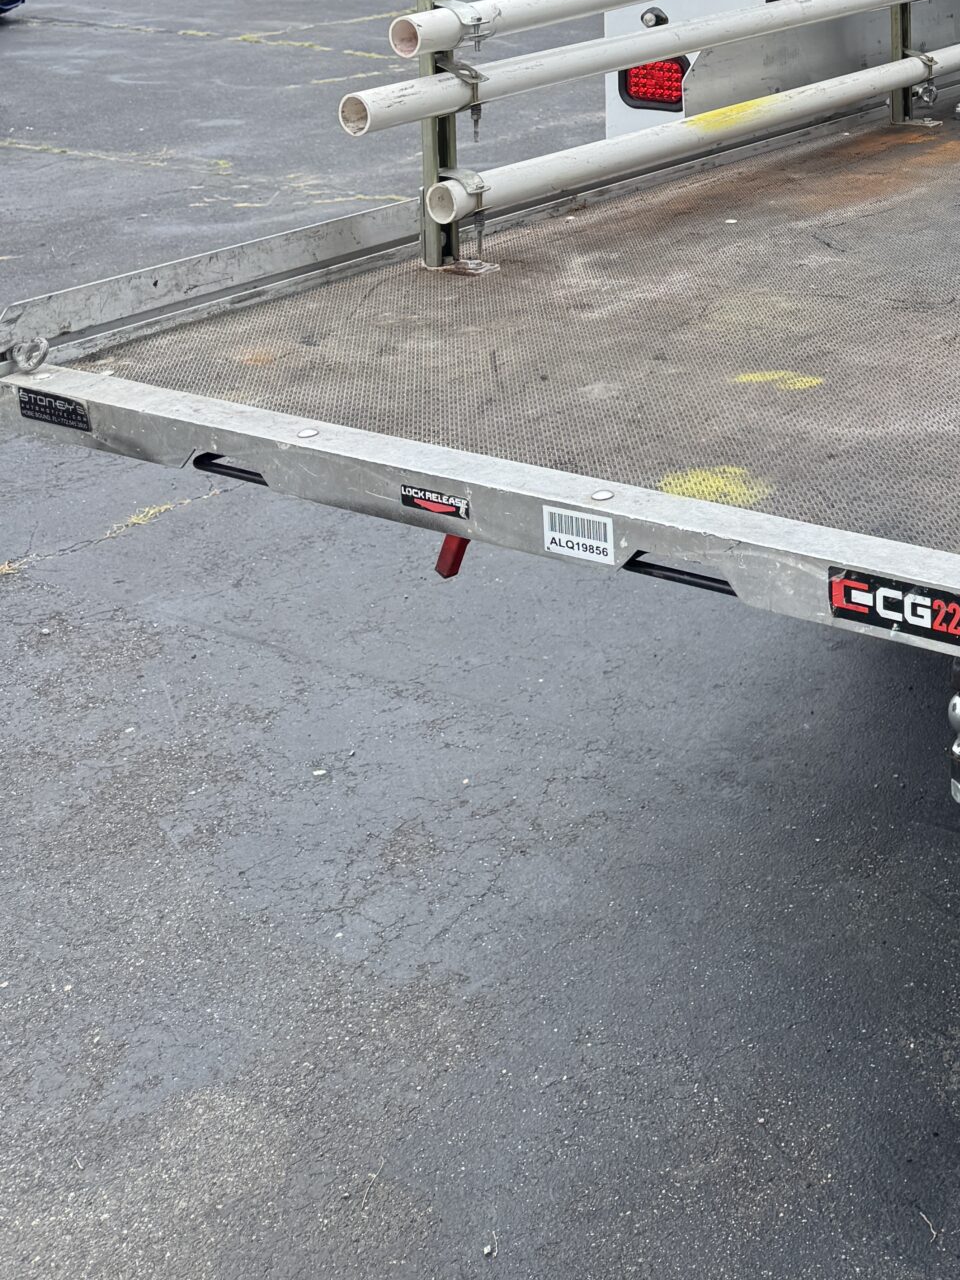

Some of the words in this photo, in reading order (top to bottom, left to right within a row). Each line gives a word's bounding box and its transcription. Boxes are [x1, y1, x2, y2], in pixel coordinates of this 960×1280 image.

[401, 486, 425, 499] LOCK
[425, 491, 468, 509] RELEASE
[549, 536, 609, 557] ALQ19856
